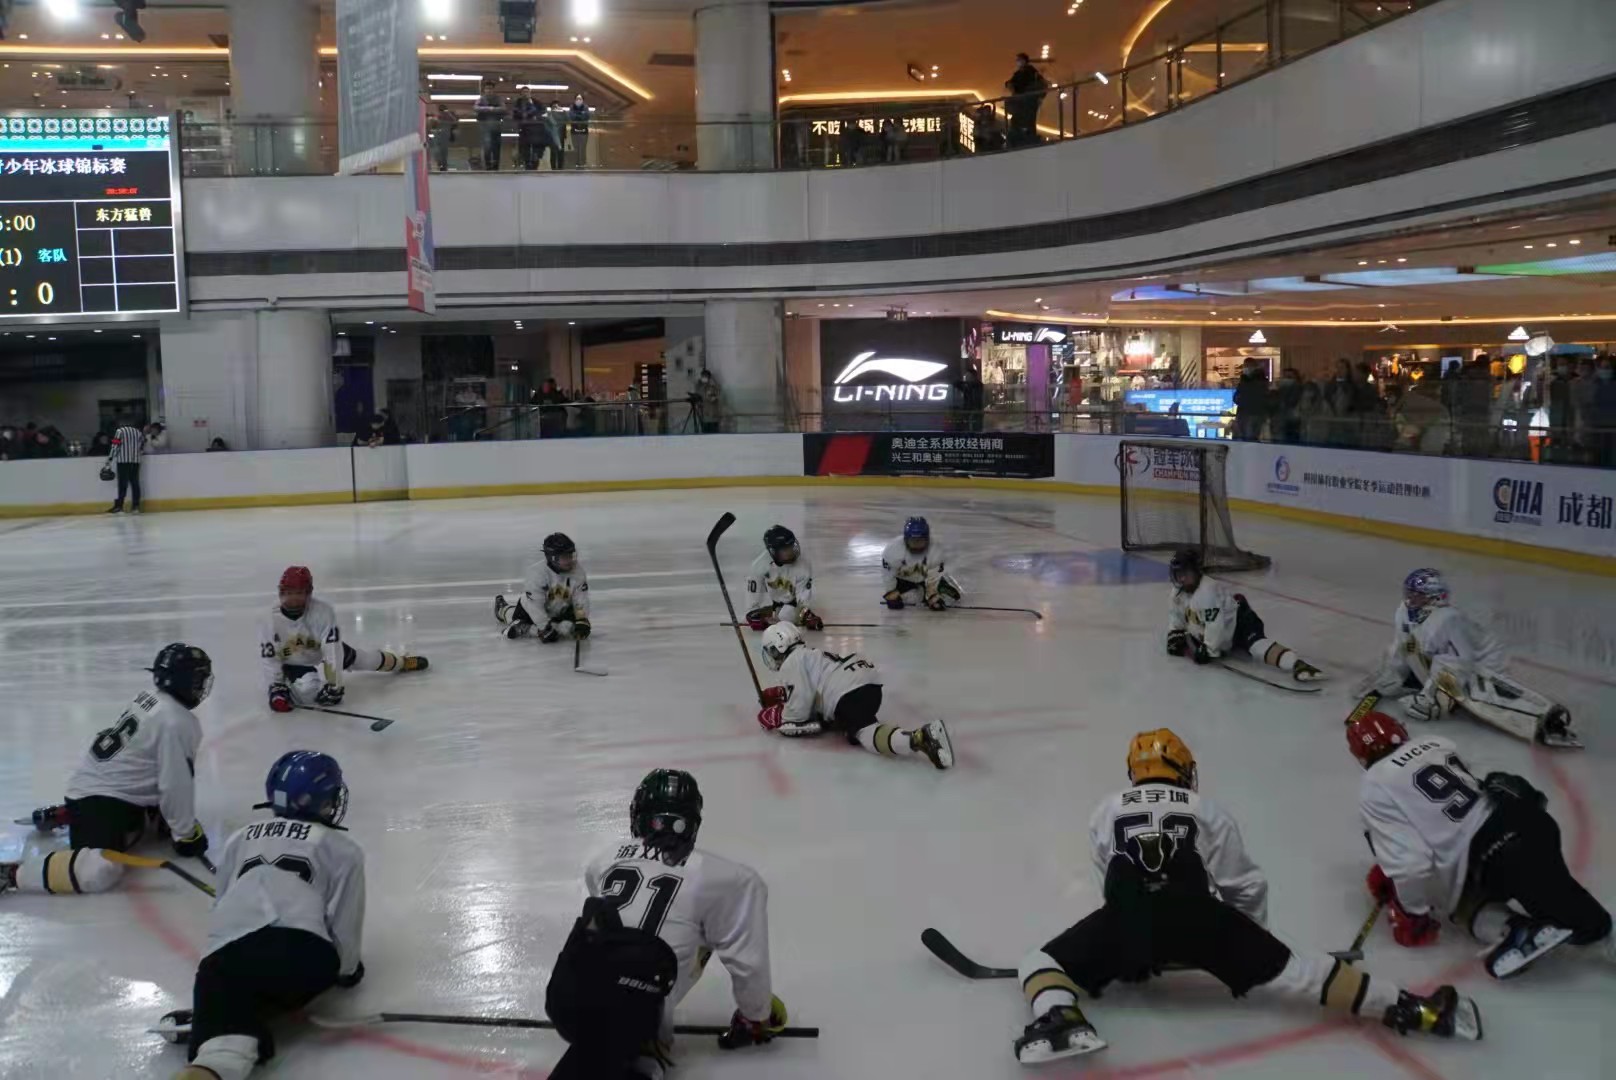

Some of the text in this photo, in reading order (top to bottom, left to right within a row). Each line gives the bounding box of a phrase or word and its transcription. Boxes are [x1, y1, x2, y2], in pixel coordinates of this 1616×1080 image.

[0, 157, 127, 175] 少年冰球锦标赛
[95, 207, 153, 222] 东方猛兽
[37, 247, 68, 263] 客队
[37, 281, 54, 305] 0
[1001, 331, 1033, 342] LI-NING
[833, 384, 949, 402] LI-NING
[891, 437, 1004, 451] 奥迪全系授权经销商
[891, 452, 943, 463] 兴三和奥迪
[1557, 492, 1613, 529] 成都
[600, 865, 684, 936] 21
